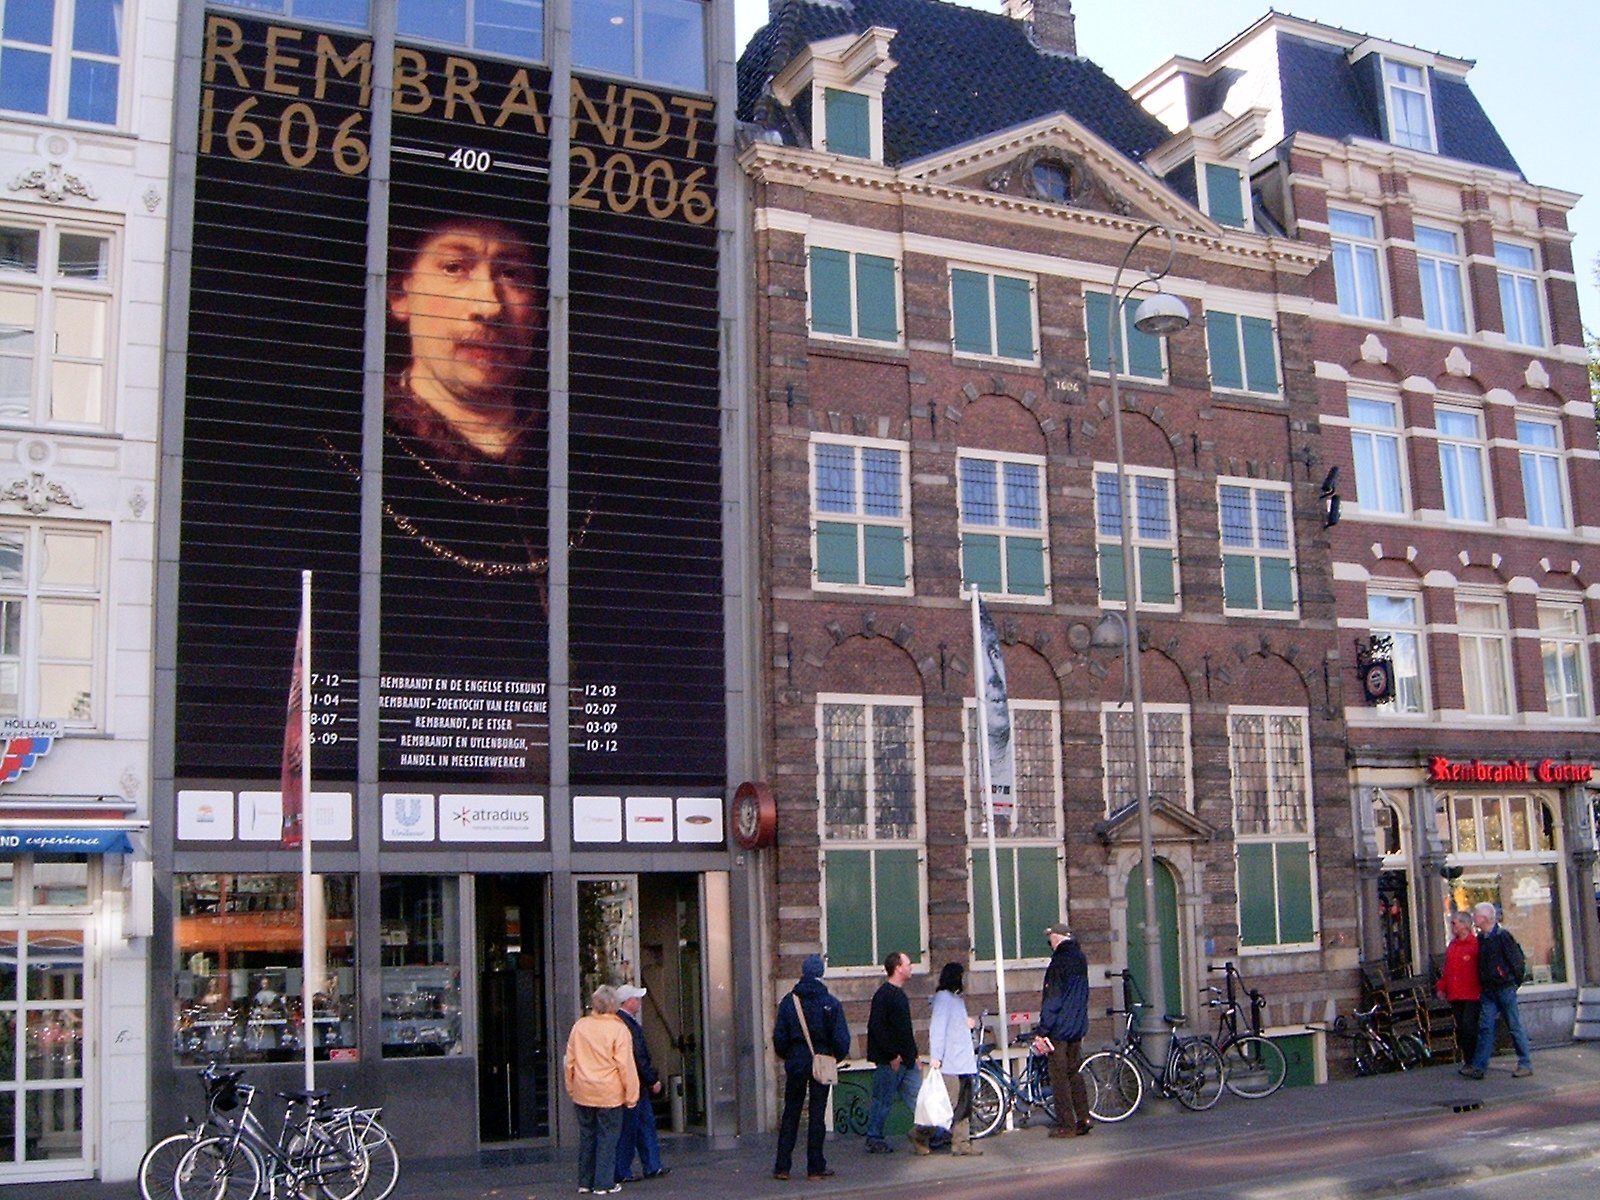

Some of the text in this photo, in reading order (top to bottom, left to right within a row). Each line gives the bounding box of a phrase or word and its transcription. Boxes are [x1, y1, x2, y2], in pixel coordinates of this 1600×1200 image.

[203, 15, 715, 159] REMBRANDT
[200, 88, 370, 176] 1606
[448, 147, 492, 173] 400
[569, 146, 716, 225] 2006
[380, 677, 547, 695] REMBRANDT EN DE ENGELSE ETSKUNST
[486, 700, 502, 712] VAN
[504, 701, 521, 713] EEN
[522, 701, 548, 714] GENIE
[4, 720, 57, 730] HOLLAND
[472, 718, 485, 731] DE
[486, 719, 513, 732] ETSER
[400, 735, 453, 748] REMBRANDT
[455, 737, 468, 749] EN
[400, 754, 527, 769] HANDEL IN MEESTERWERKEN
[1429, 755, 1594, 783] Rembrandt Corner
[472, 809, 529, 822] atradius
[25, 835, 100, 848] experience
